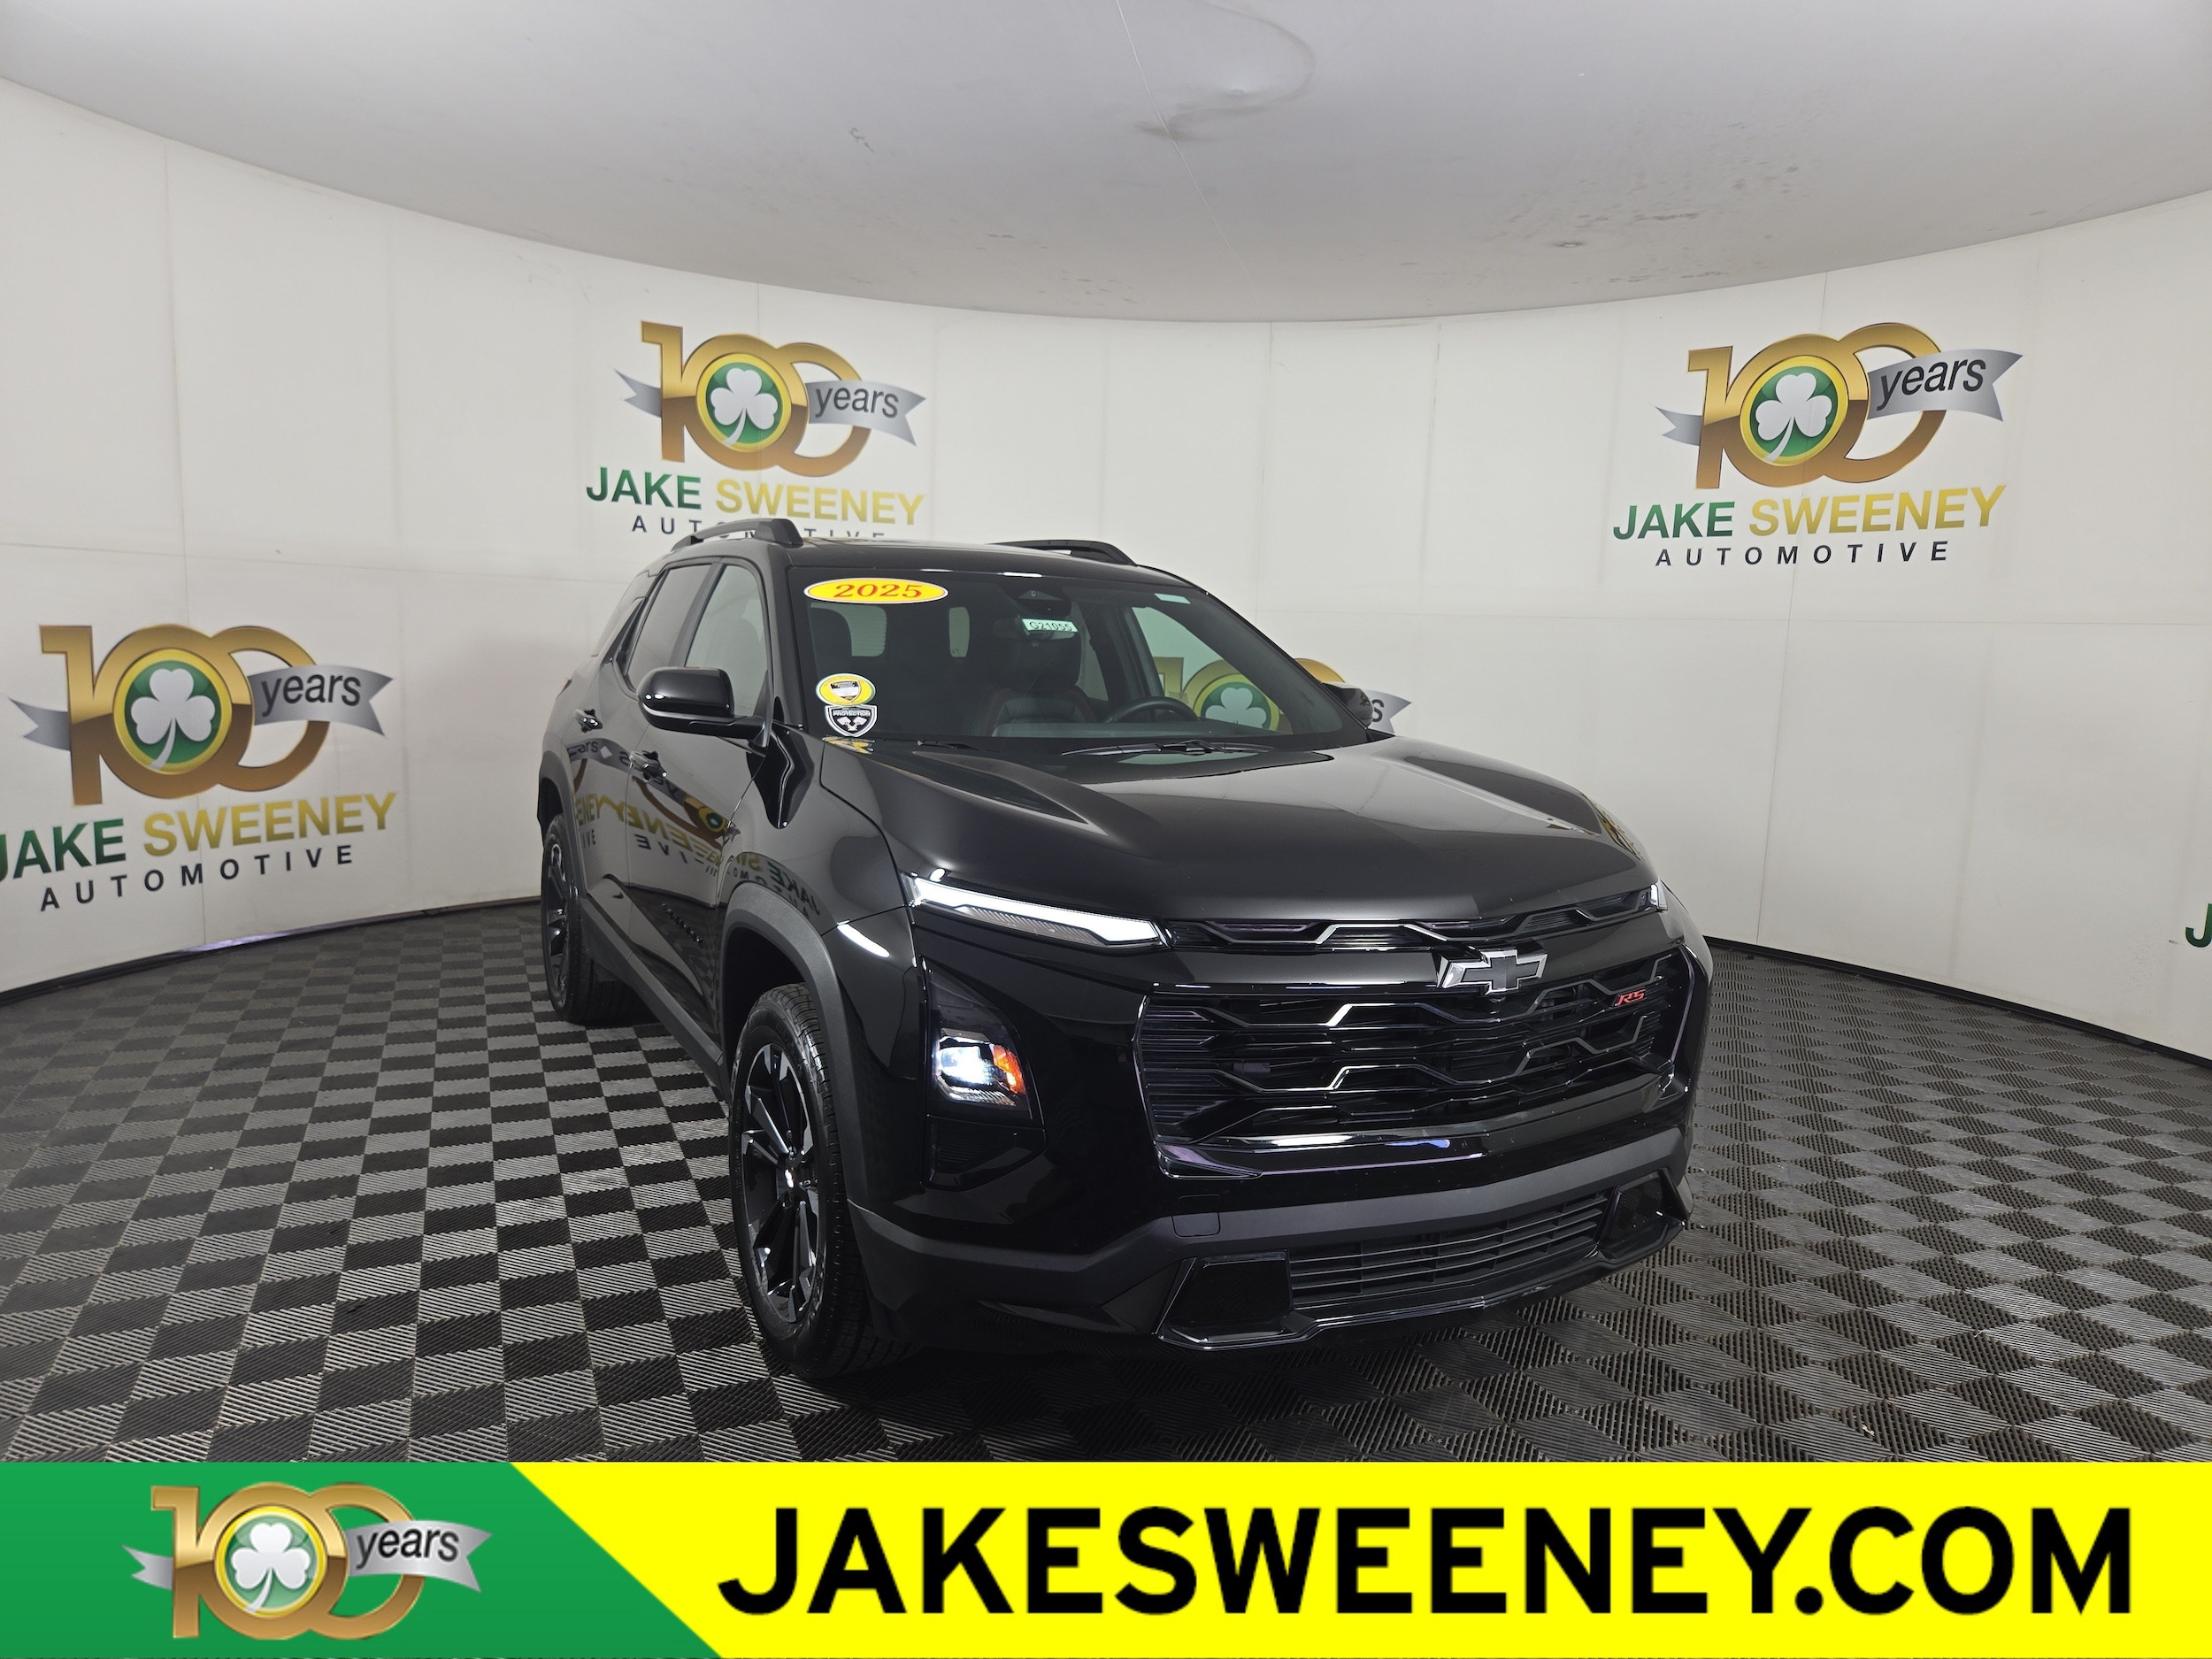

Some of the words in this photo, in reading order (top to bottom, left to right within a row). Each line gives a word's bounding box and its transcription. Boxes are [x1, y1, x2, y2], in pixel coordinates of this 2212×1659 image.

[815, 385, 899, 418] years
[1877, 357, 1986, 411] years
[586, 466, 702, 510] JAKE
[716, 480, 925, 526] SWEENEY
[1613, 501, 1735, 540] JAKE
[1748, 485, 2007, 536] SWEENEY
[1655, 541, 1948, 567] AUTOMOTIVE
[833, 584, 922, 599] 2025
[261, 672, 361, 717] years
[143, 792, 398, 858] SWEENEY
[40, 845, 353, 912] AUTOMOTIVE
[1617, 989, 1647, 1006] RS
